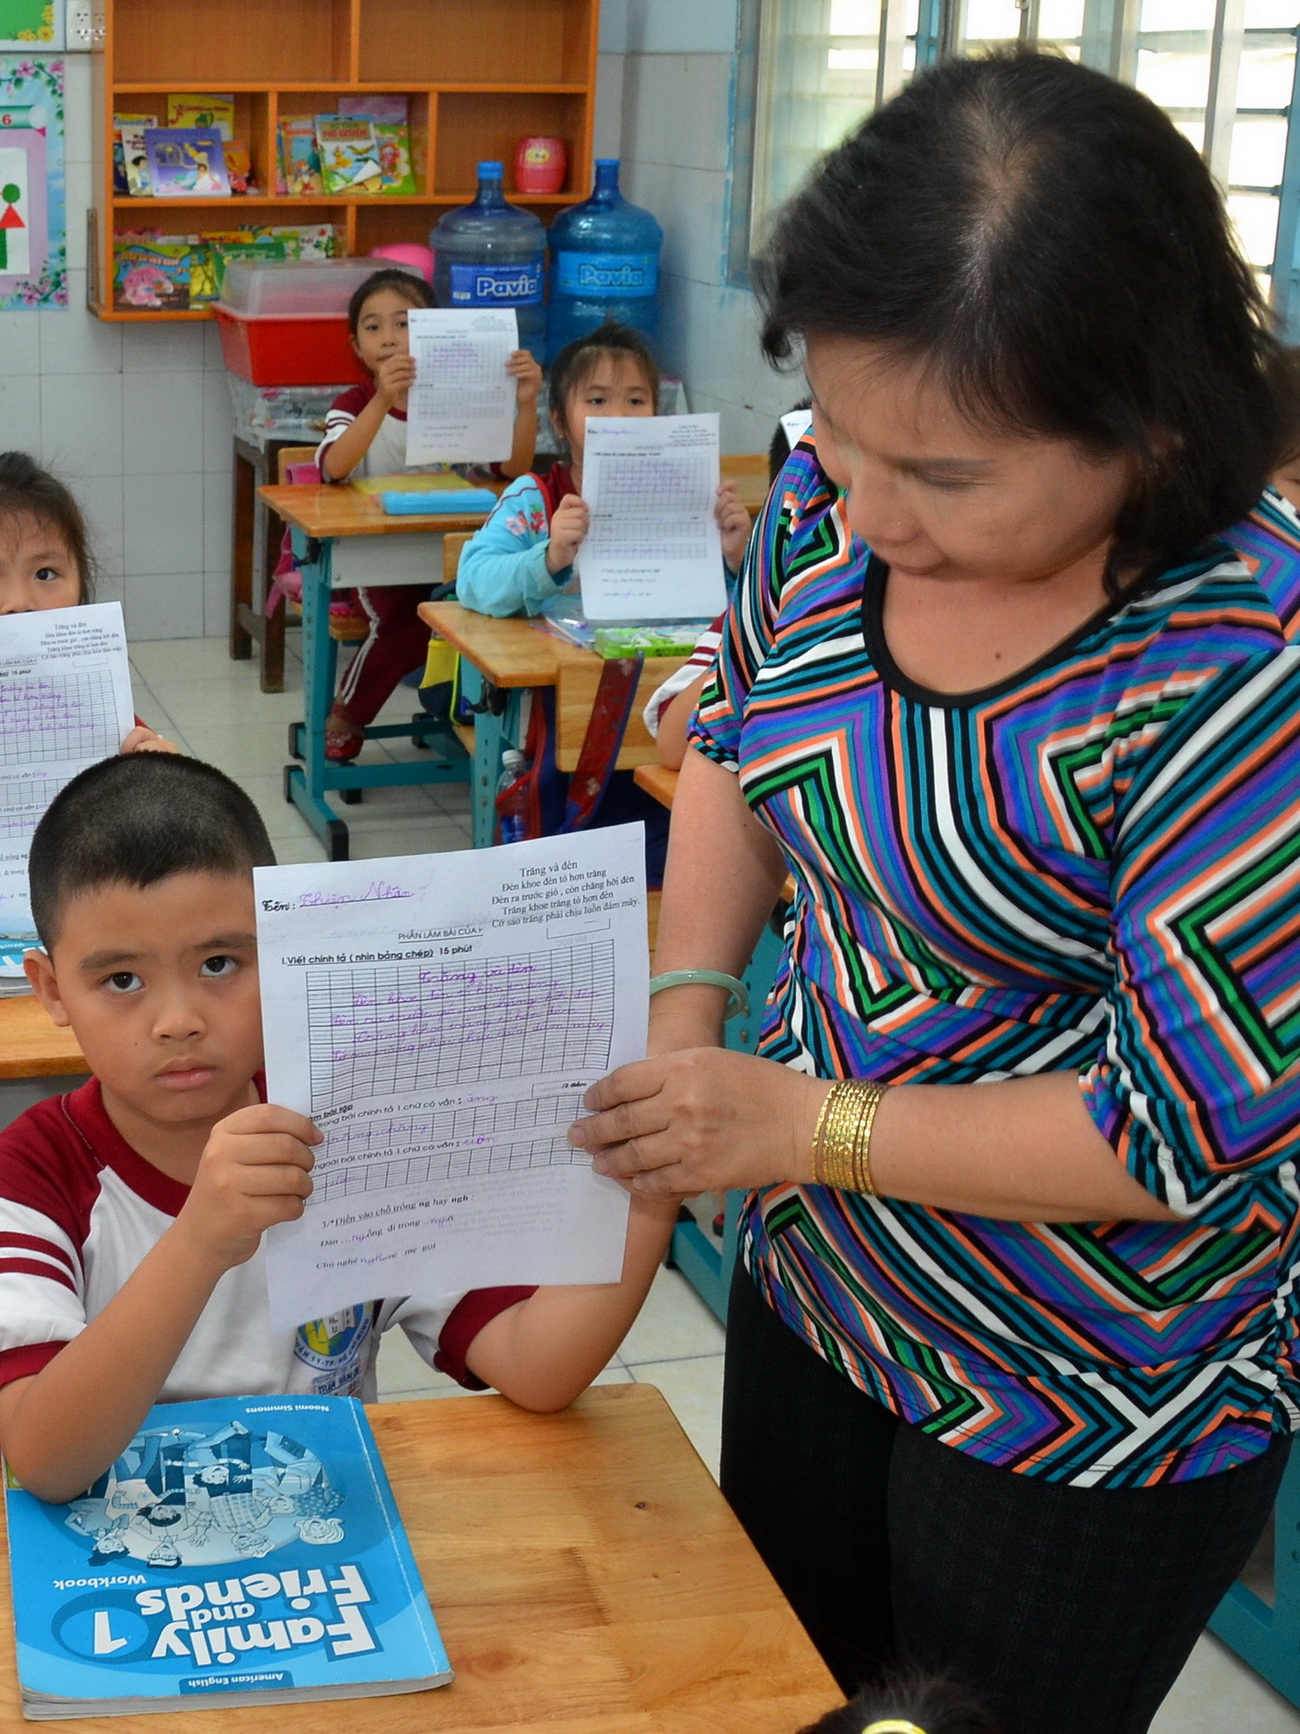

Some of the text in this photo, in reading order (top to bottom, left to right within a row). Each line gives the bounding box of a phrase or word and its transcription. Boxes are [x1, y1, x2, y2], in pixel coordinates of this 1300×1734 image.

[2, 114, 12, 126] 6
[477, 275, 537, 297] Pavia
[580, 263, 644, 286] Pavia
[502, 868, 607, 892] Đèn khoe đèn tỏ hơn trăng
[520, 860, 578, 877] Trăng và đèn
[492, 895, 509, 905] Đèn
[522, 890, 543, 901] trước
[545, 887, 559, 899] gió
[565, 885, 580, 895] còn
[581, 880, 604, 892] chăng
[620, 875, 635, 884] đèn
[502, 890, 614, 916] Trăng khoe trăng tỏ hơn đèn
[507, 918, 521, 926] sao
[523, 913, 543, 924] trăng
[546, 909, 563, 923] phải
[565, 906, 582, 918] chịu
[603, 900, 619, 911] đám
[246, 1404, 329, 1414] Naomi Simmons
[53, 1573, 146, 1590] Workbook
[134, 1564, 371, 1622] Friends
[192, 1603, 255, 1629] and
[94, 1611, 129, 1654] 1
[152, 1605, 376, 1667] Family
[188, 1672, 284, 1687] American English
